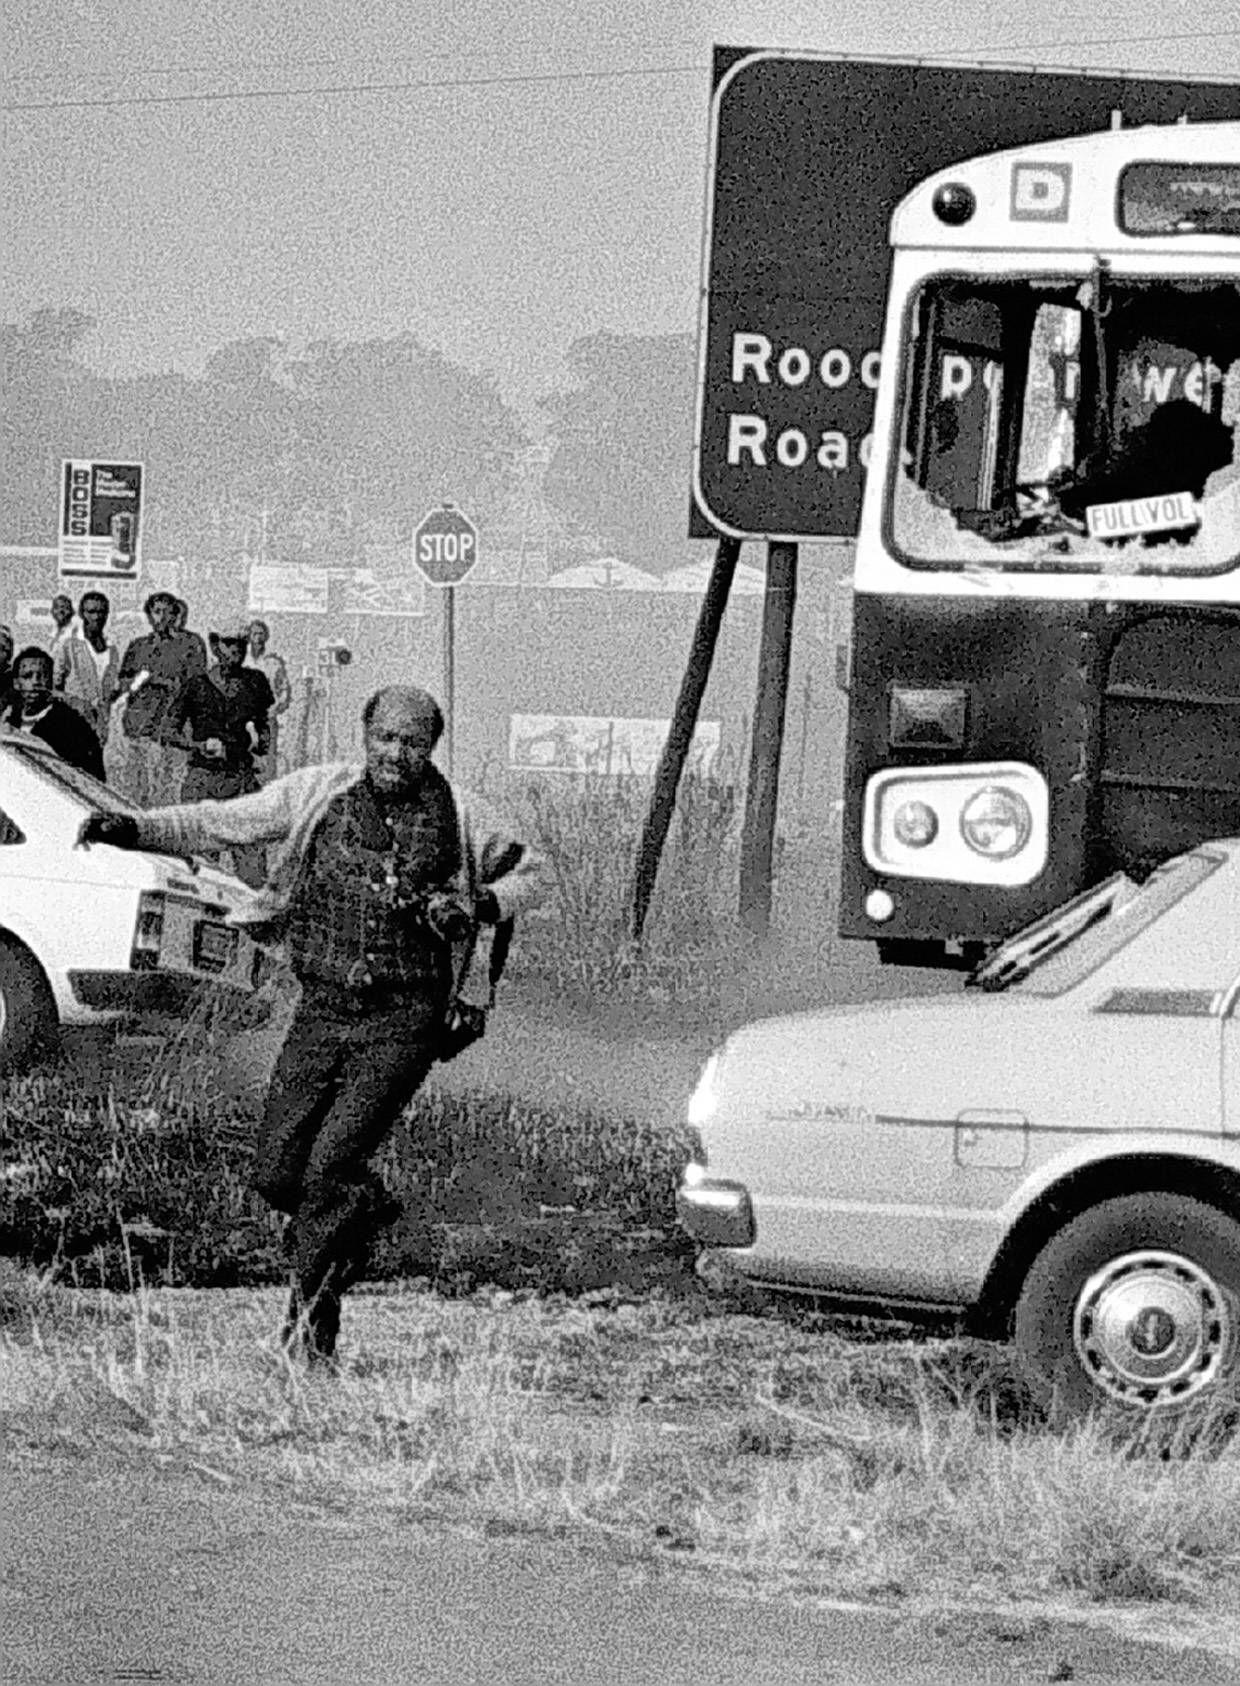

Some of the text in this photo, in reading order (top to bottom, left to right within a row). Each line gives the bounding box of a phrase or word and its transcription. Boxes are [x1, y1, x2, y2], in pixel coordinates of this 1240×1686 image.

[71, 469, 90, 536] BOSS
[1092, 497, 1190, 532] FULL VOL
[420, 533, 473, 562] STOP
